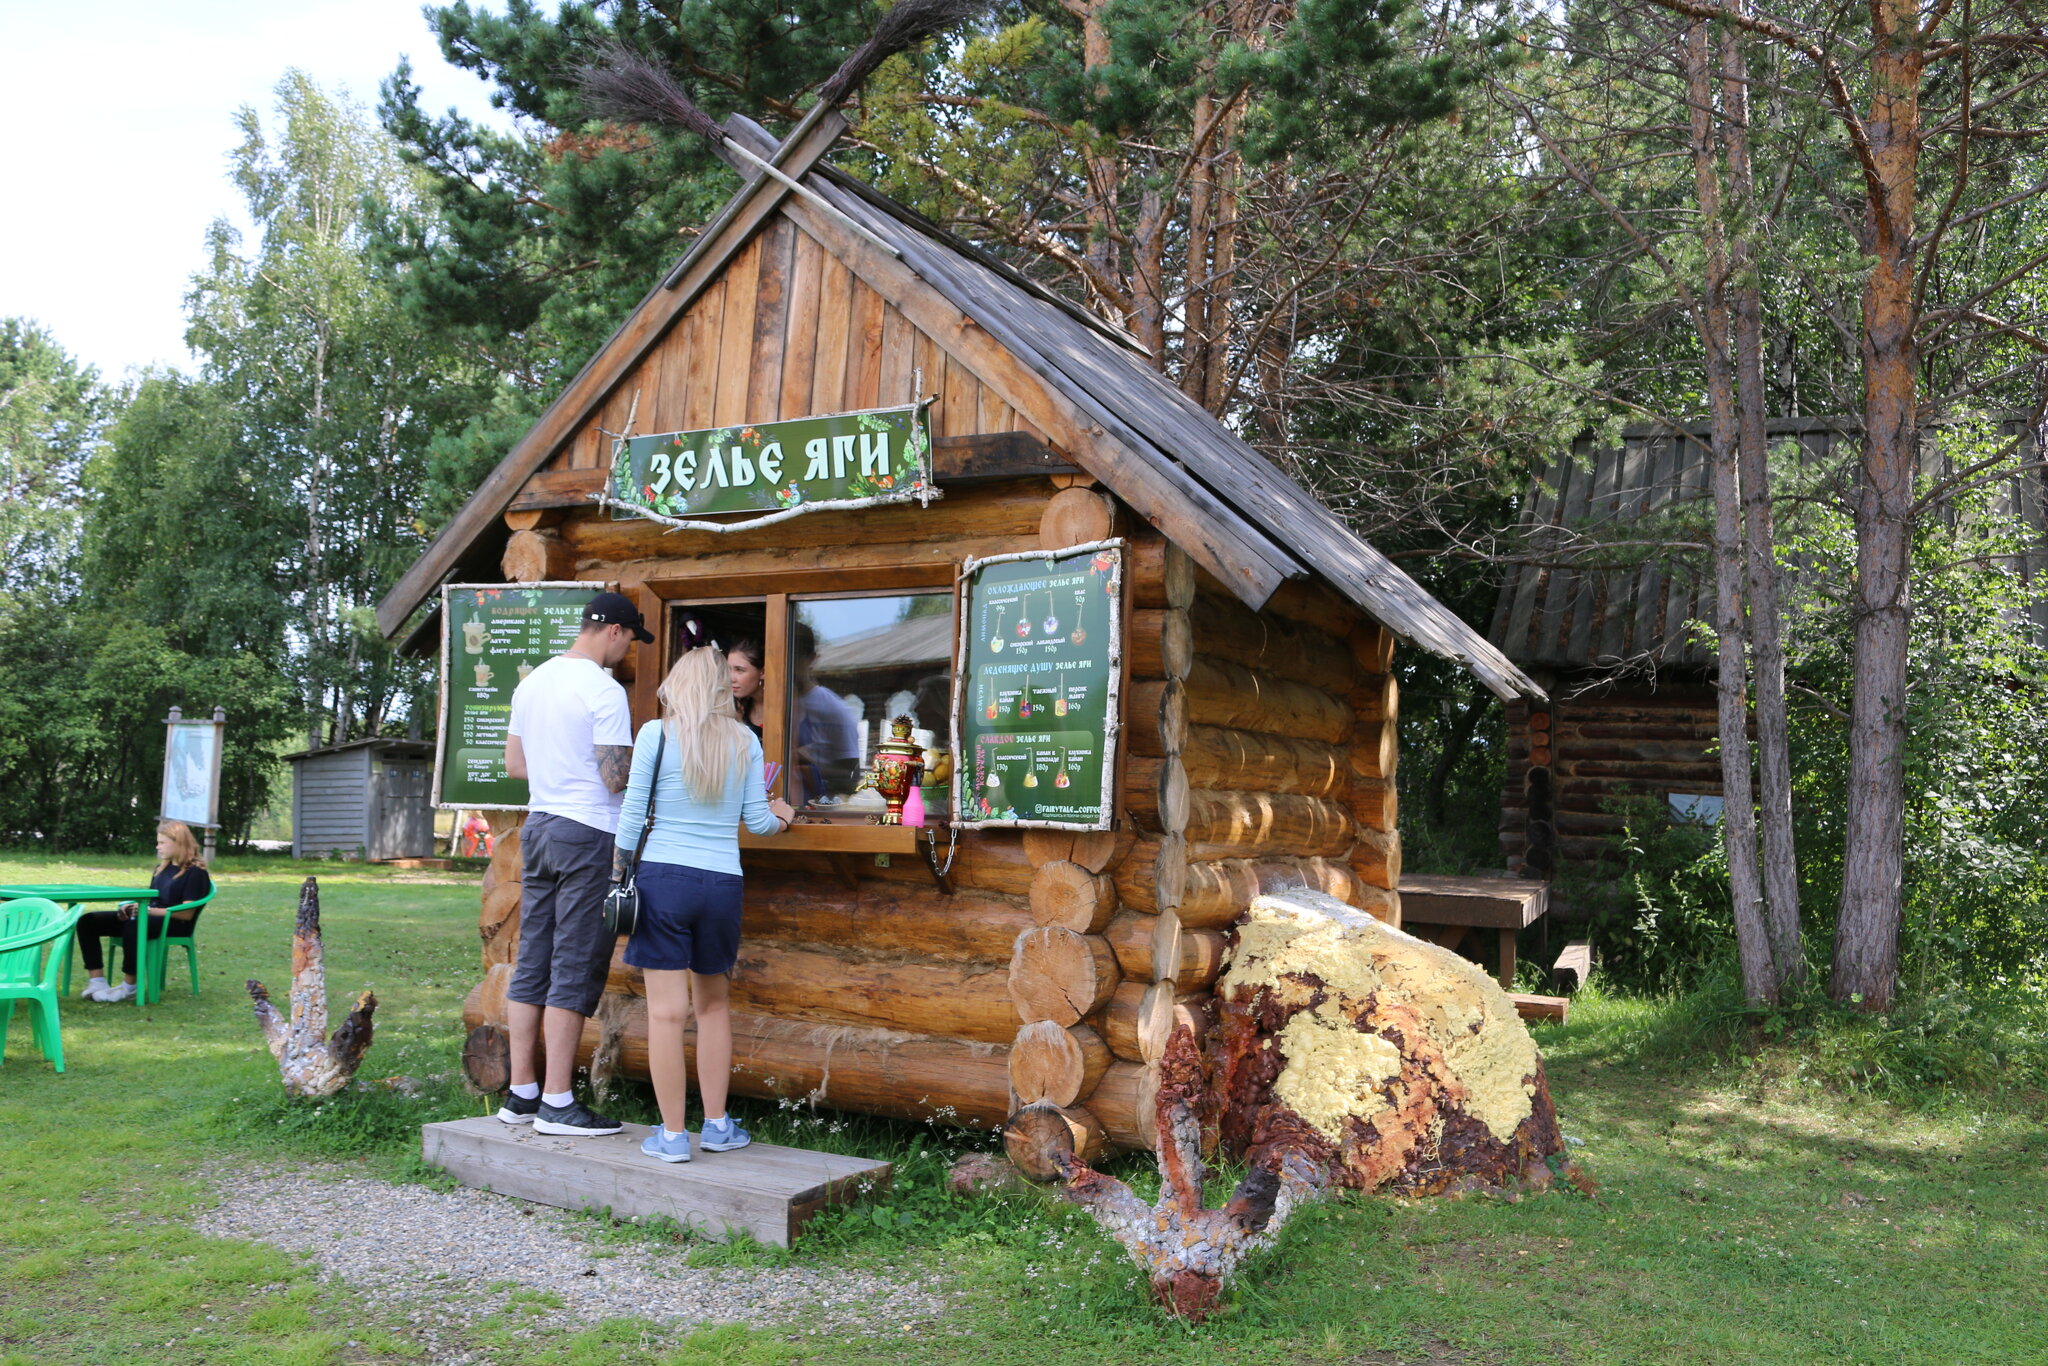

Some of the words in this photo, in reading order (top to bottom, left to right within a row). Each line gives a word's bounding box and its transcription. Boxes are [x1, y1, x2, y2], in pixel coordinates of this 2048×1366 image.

[650, 442, 784, 495] ЗЕЛЬЕ
[804, 433, 890, 481] ЯГИ
[987, 580, 1047, 595] ОХЛОЖДАЮЩЕЕ
[1049, 577, 1070, 588] ЗЕЛЬЕ
[1071, 576, 1085, 586] ЯГИ
[544, 607, 571, 615] ЗЕЛЬЕ
[573, 607, 584, 615] ЯГ
[1030, 662, 1054, 673] ДУШУ
[1055, 661, 1077, 670] ЗЕЛЬЕ
[1078, 660, 1092, 669] ЯГИ
[1016, 735, 1036, 743] ЗЕЛЬЕ
[1038, 734, 1051, 743] ЯГИ
